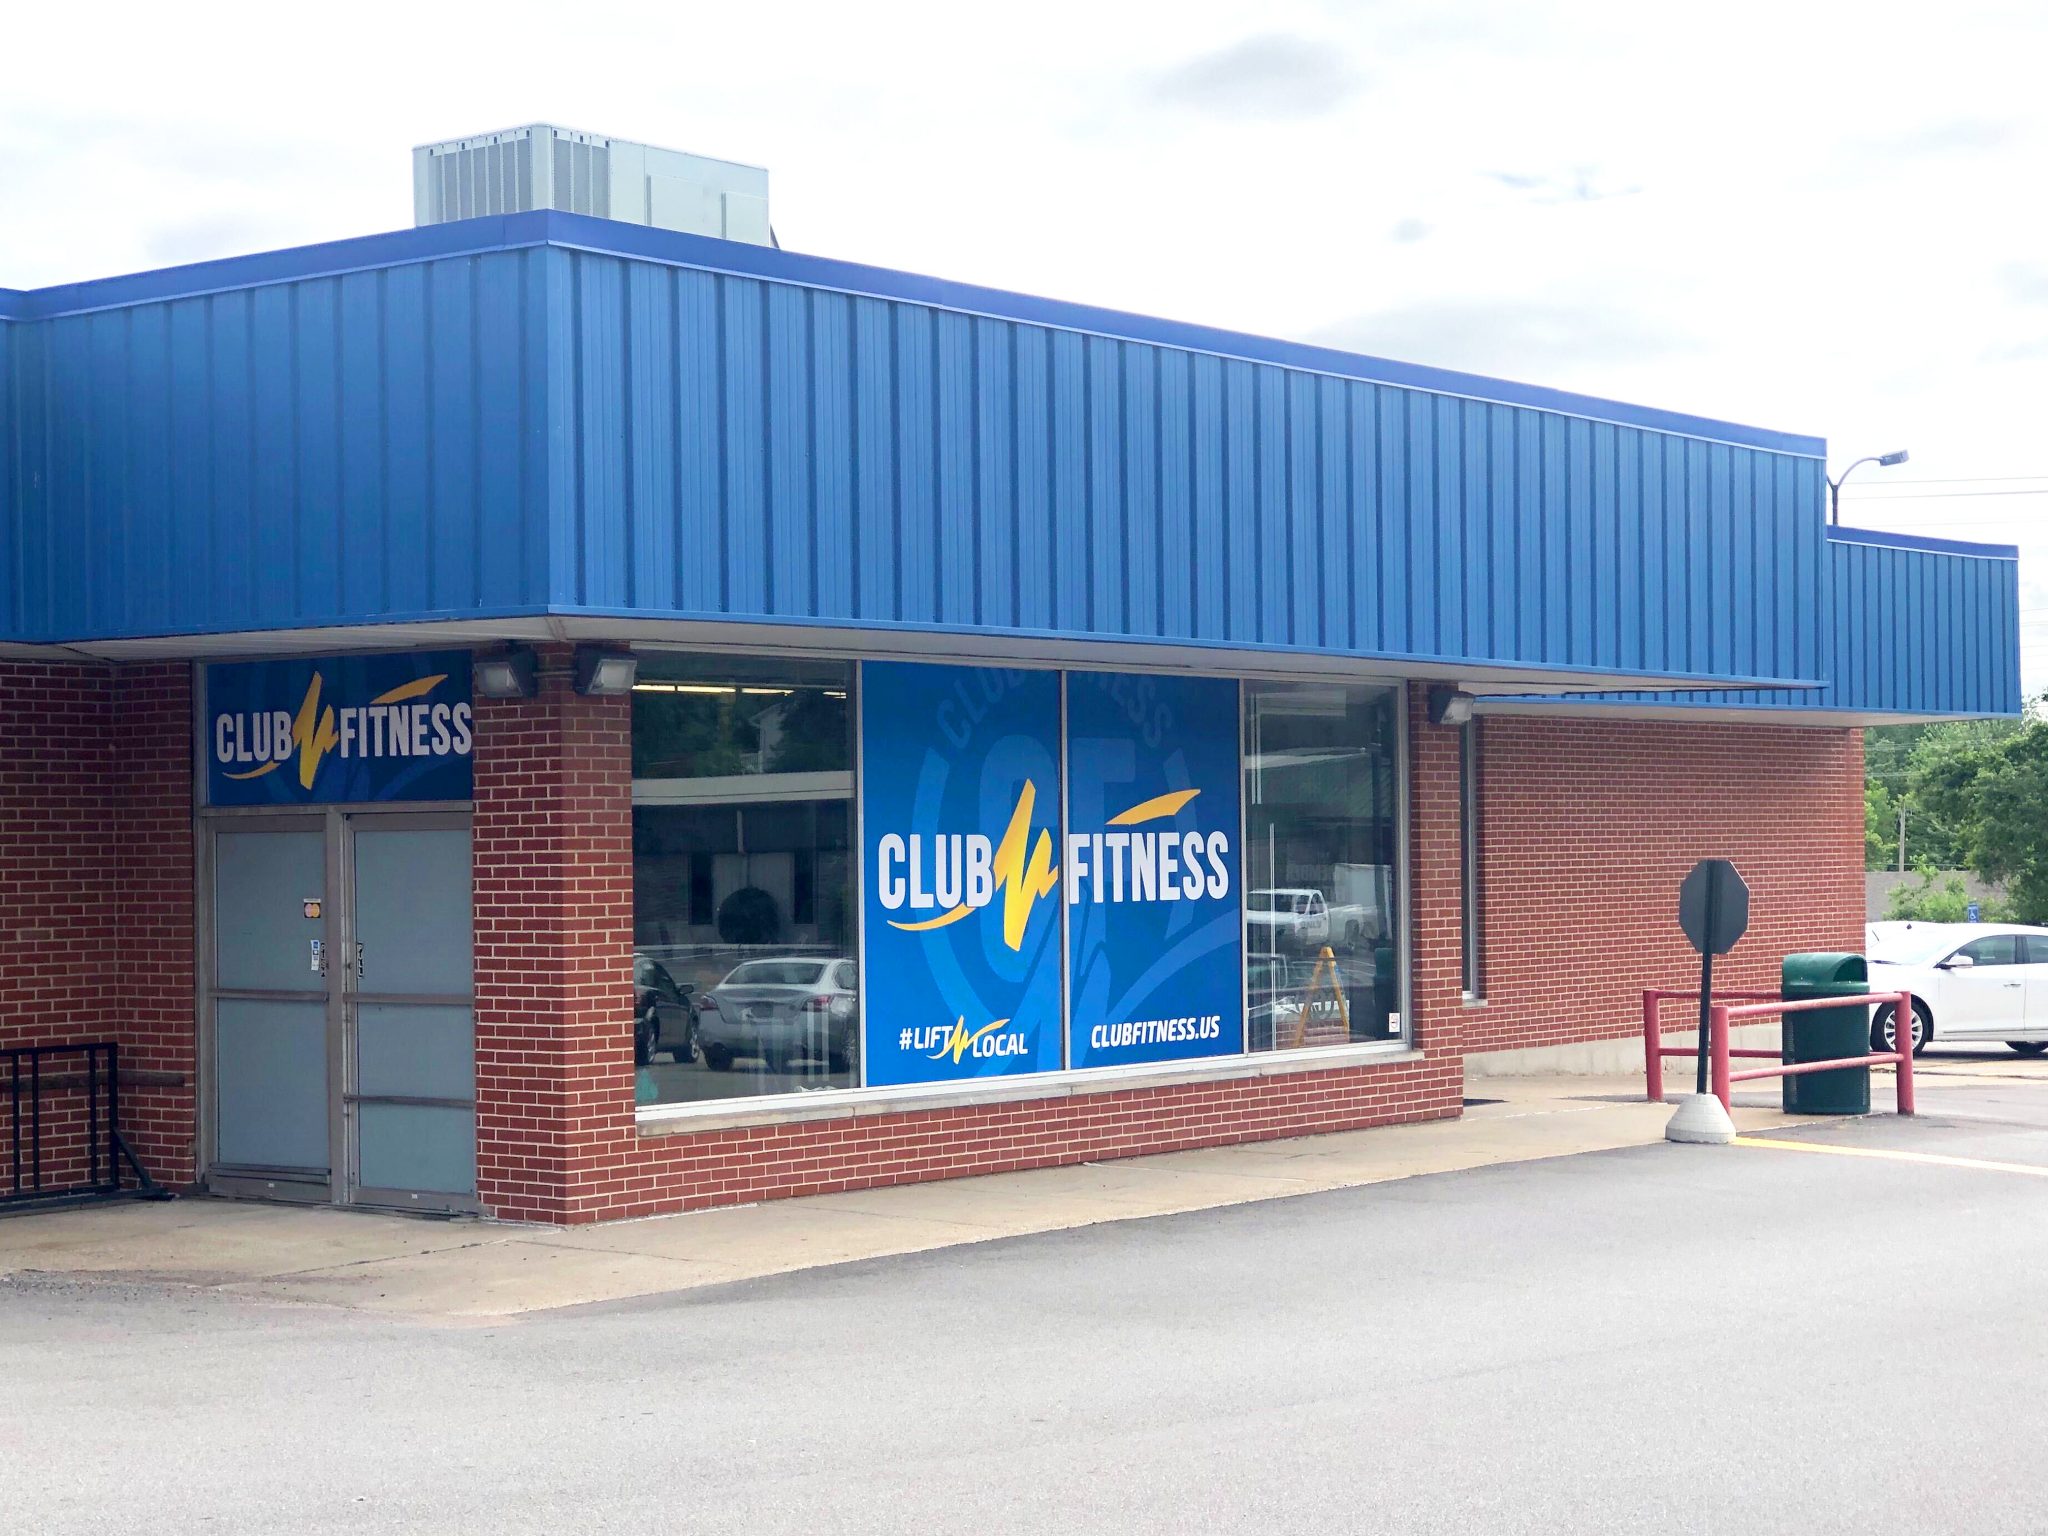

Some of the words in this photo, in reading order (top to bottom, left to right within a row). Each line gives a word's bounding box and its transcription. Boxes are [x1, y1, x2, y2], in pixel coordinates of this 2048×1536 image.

[216, 711, 292, 763] CLUB
[340, 702, 472, 758] FITNESS
[878, 833, 993, 910] CLUB
[1068, 830, 1230, 904] FITNESS
[899, 1025, 954, 1051] #LIFT
[972, 1033, 1029, 1058] LOCAL
[1091, 1015, 1221, 1049] CLUBFITNESS.US
